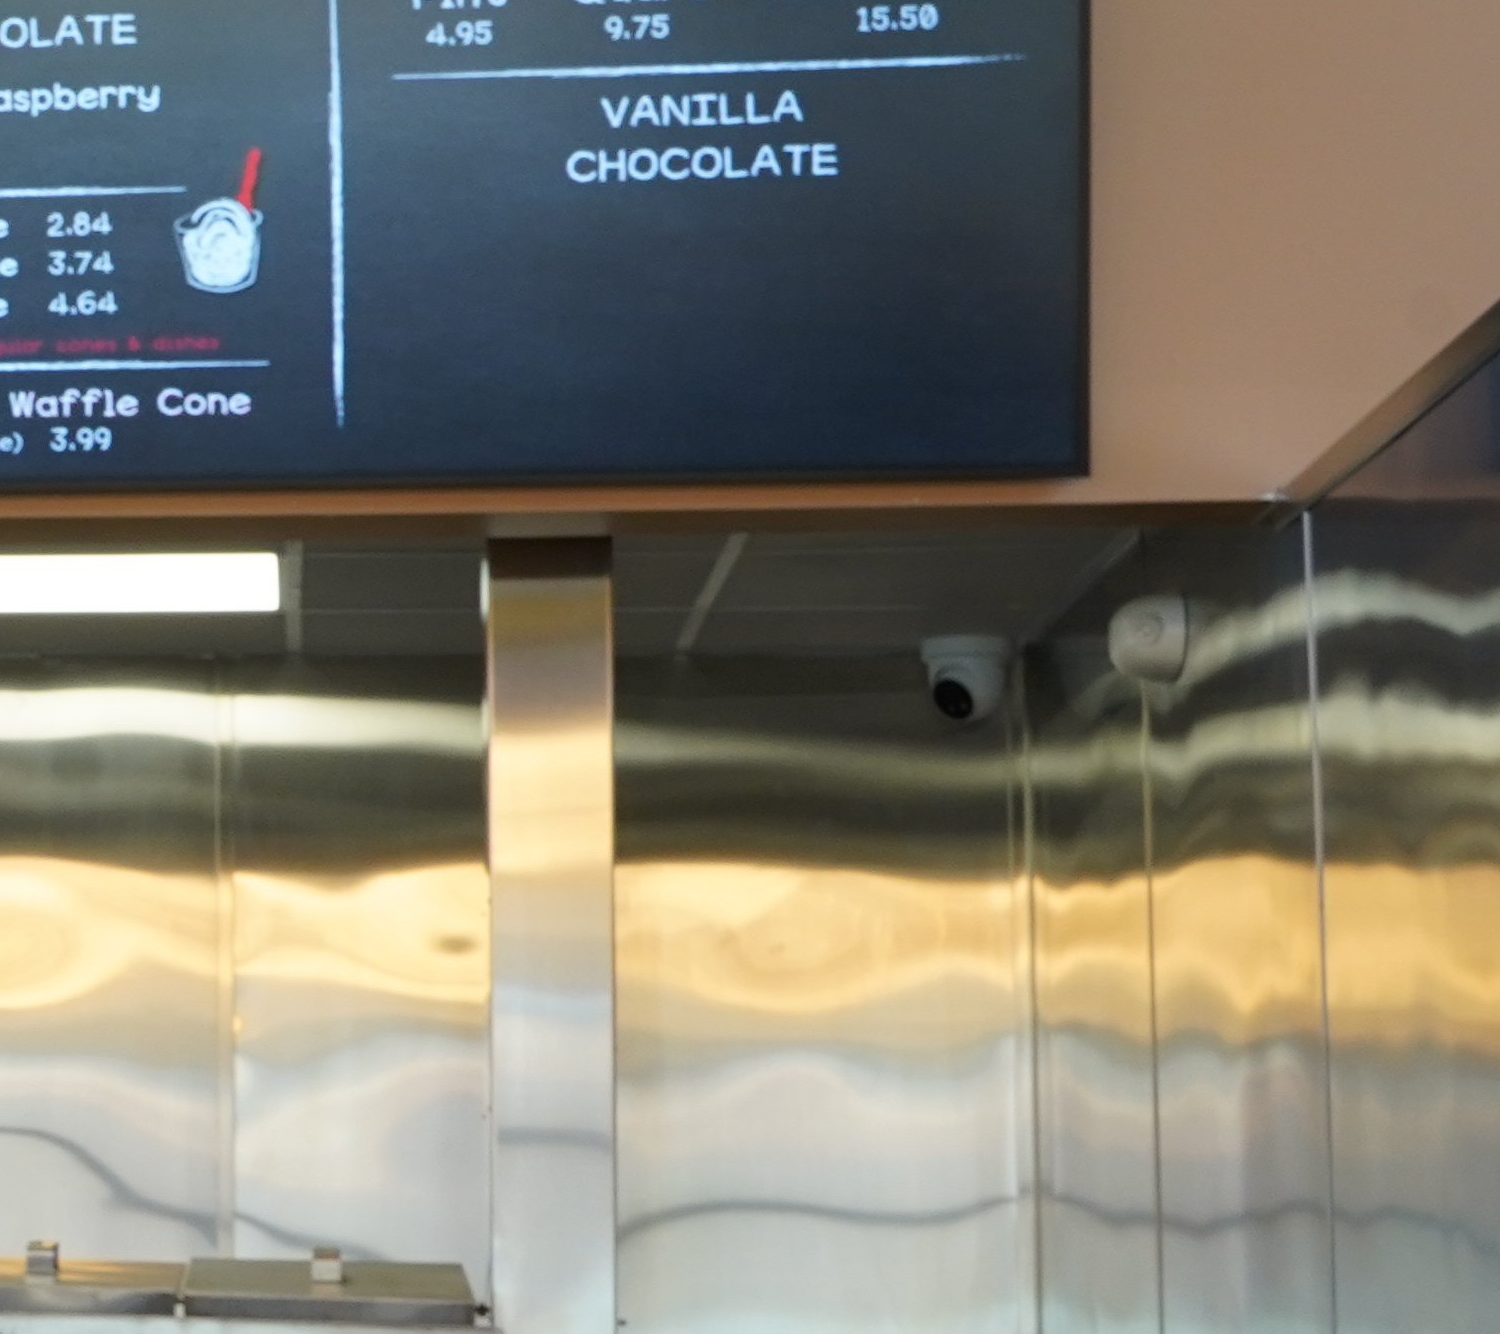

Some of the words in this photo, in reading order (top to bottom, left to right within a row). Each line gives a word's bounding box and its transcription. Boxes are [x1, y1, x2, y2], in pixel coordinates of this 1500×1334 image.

[604, 14, 669, 40] 9.75
[857, 4, 939, 32] 15.50
[426, 20, 492, 46] 4.95
[601, 91, 803, 128] VANILLA
[566, 143, 838, 183] CHOCOLATE
[47, 211, 112, 237] 2.84
[48, 250, 114, 275] 3.74
[48, 290, 118, 315] 4.64
[9, 388, 139, 418] Waffle
[157, 388, 251, 416] Cone
[50, 427, 112, 452] 3.99
